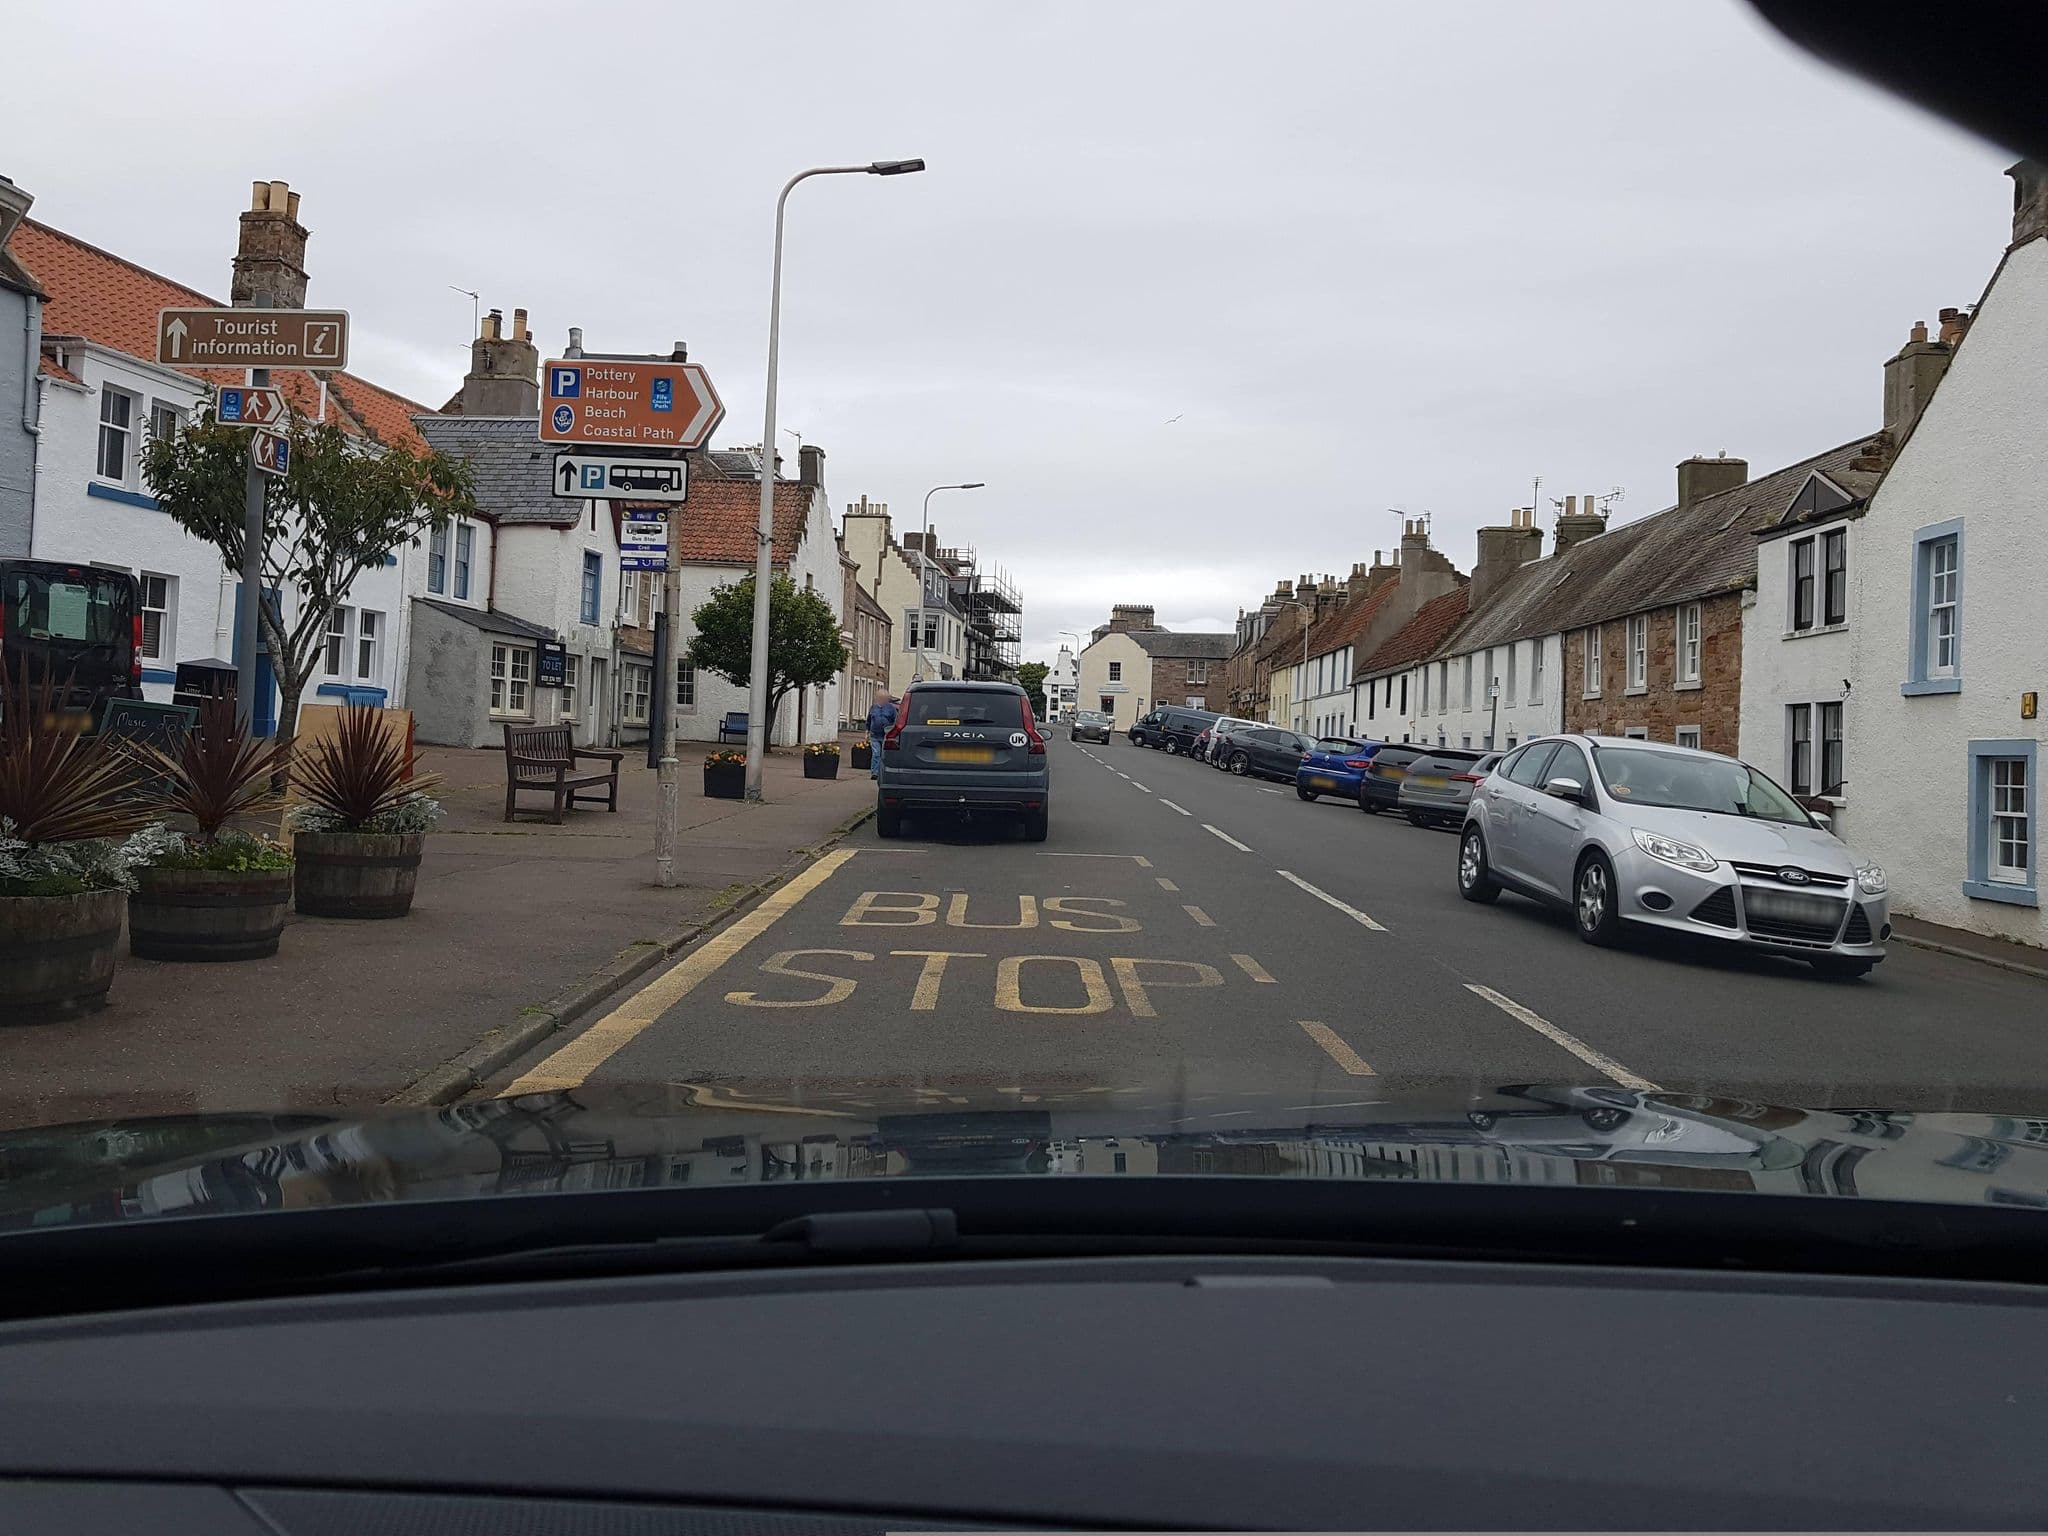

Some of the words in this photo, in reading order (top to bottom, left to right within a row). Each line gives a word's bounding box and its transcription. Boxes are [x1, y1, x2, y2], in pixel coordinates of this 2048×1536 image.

[214, 318, 278, 335] Tourist
[192, 339, 297, 356] information
[557, 370, 576, 396] P
[586, 367, 636, 382] Pottery
[585, 387, 639, 400] Harbour
[585, 405, 626, 419] Beach
[583, 424, 637, 438] Coastal
[643, 426, 674, 440] Path
[586, 466, 601, 487] P
[543, 661, 550, 670] TO
[552, 662, 562, 671] LET
[117, 711, 147, 728] Music
[1011, 736, 1025, 744] UK
[838, 891, 1143, 933] BUS
[724, 948, 1225, 1017] STOP
